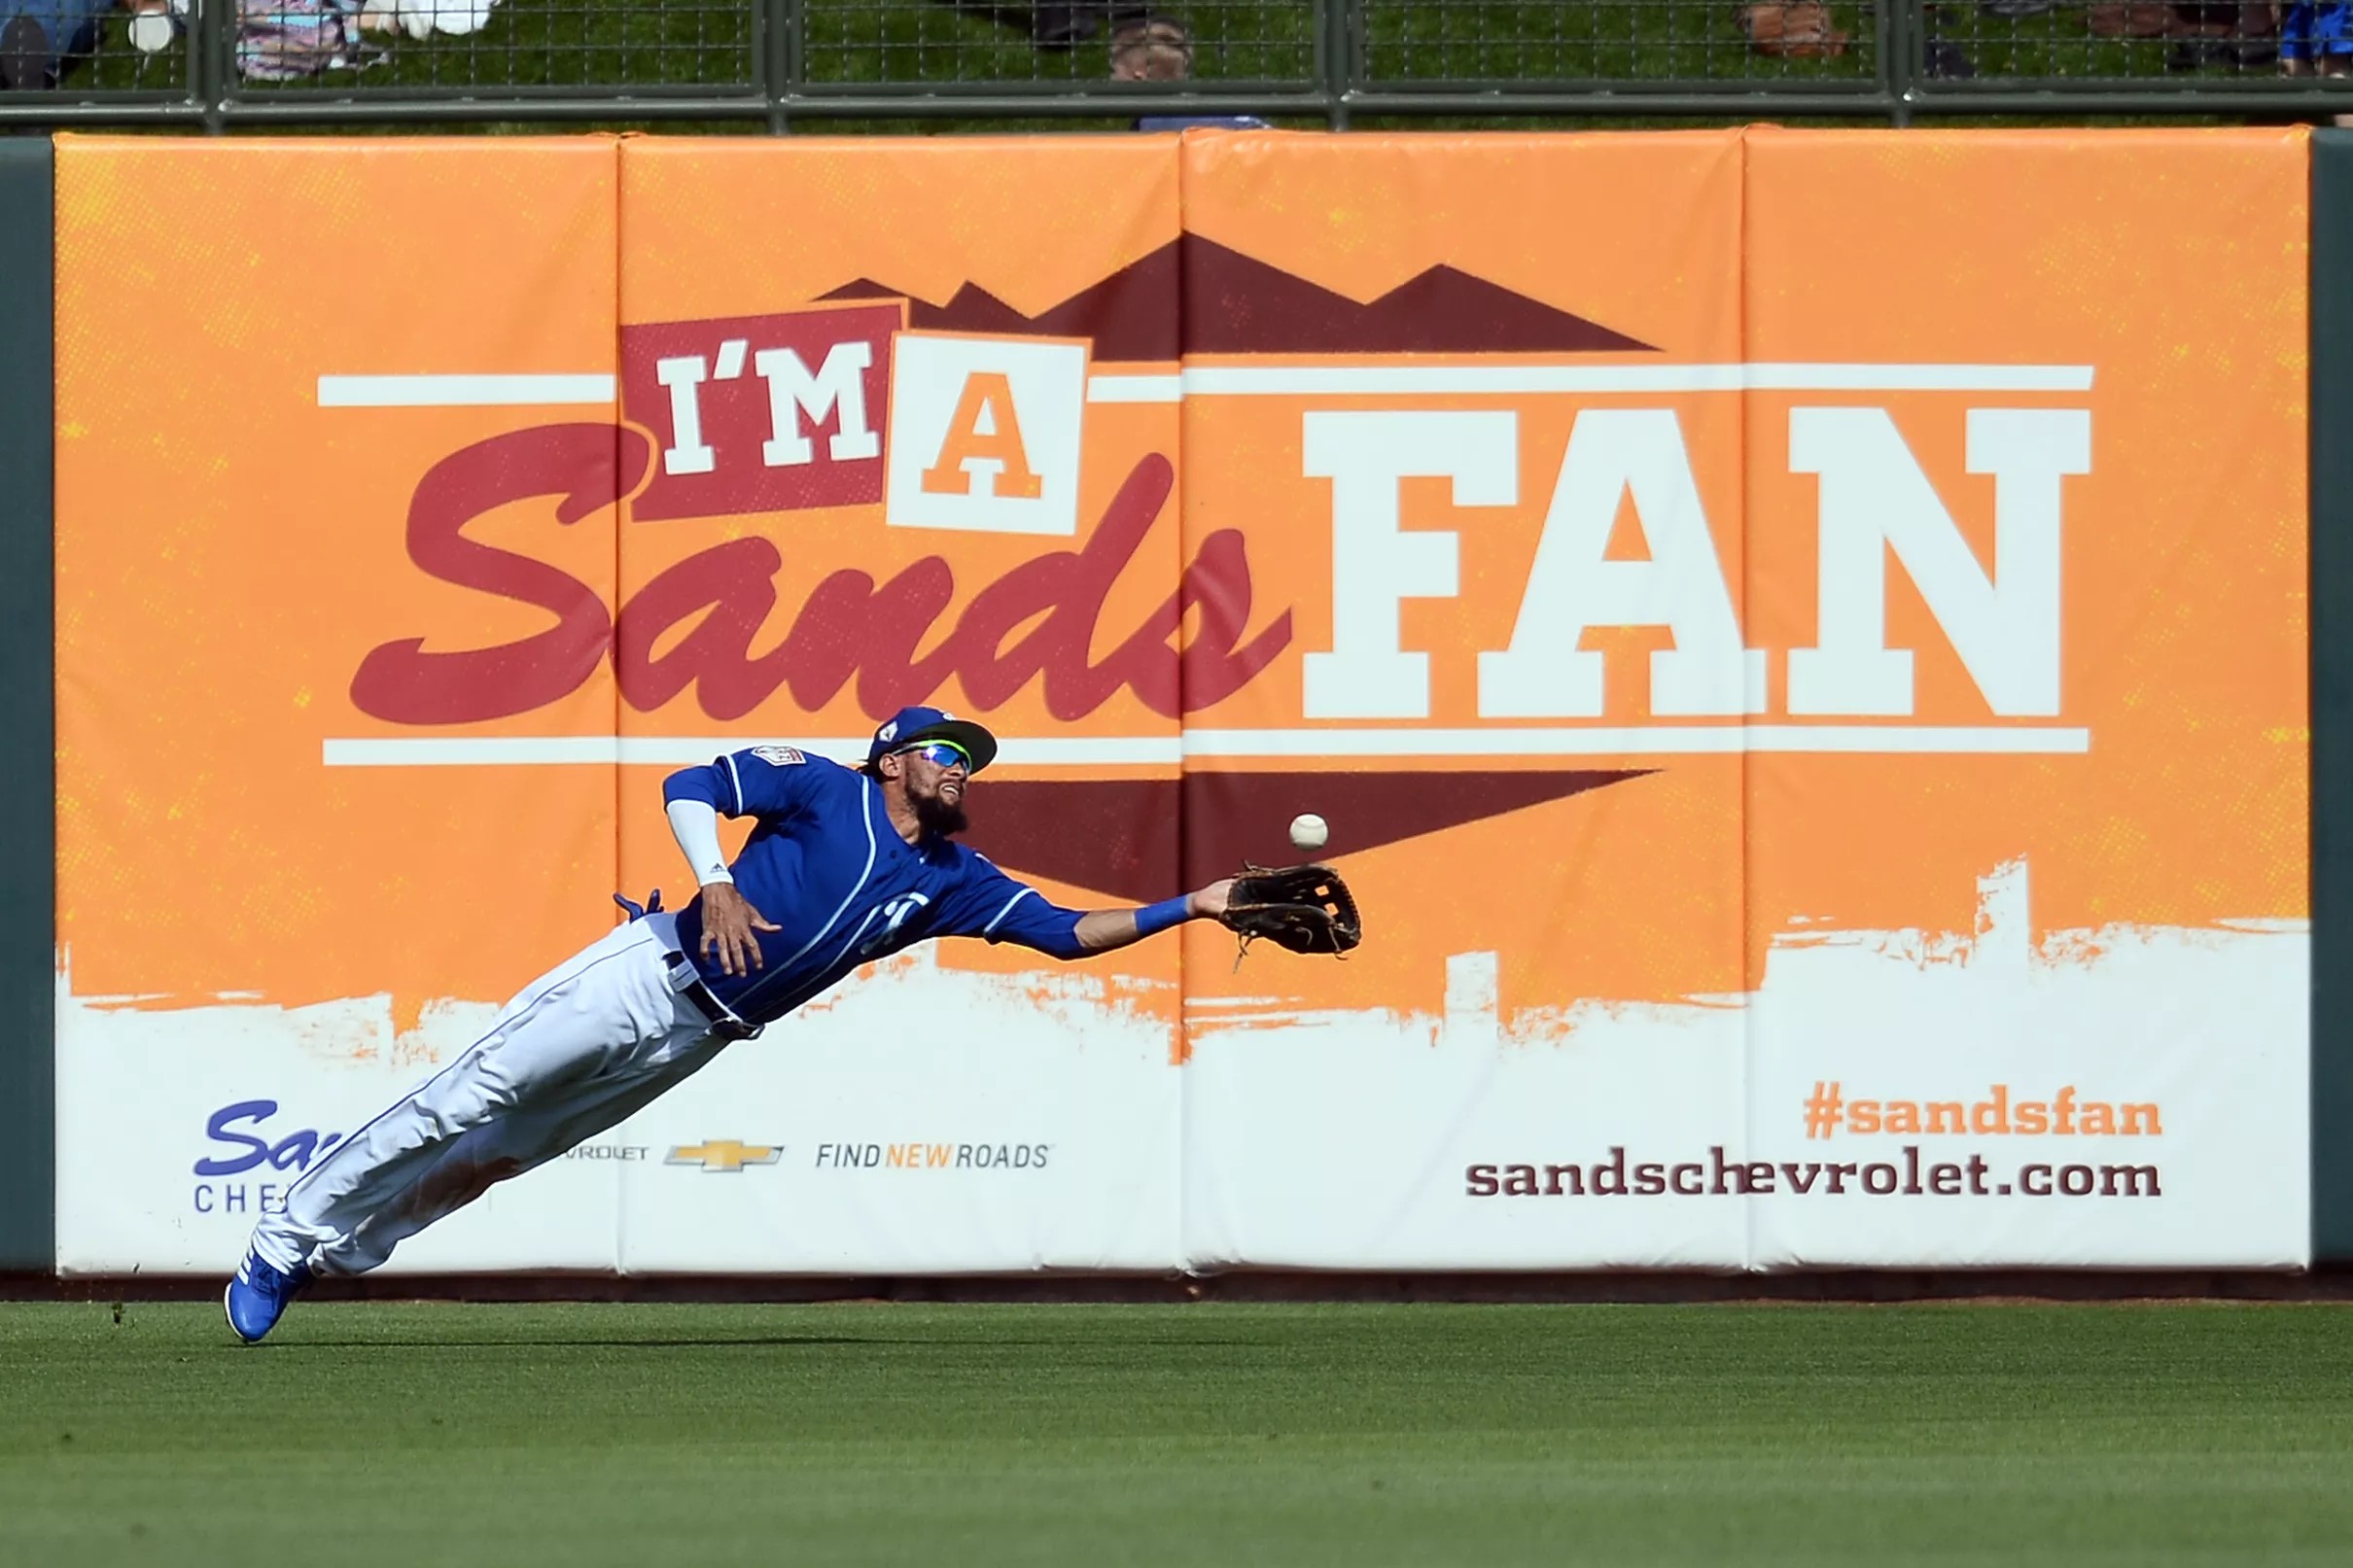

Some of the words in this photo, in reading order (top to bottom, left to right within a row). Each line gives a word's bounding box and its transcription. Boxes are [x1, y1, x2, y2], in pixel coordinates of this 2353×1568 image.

[656, 338, 880, 475] I'M
[921, 370, 1042, 499] A
[349, 421, 1292, 725] Sands
[1302, 406, 2091, 719] FAN
[1803, 1081, 2162, 1138] #sandsfan
[565, 1146, 650, 1160] VROLET
[816, 1144, 881, 1167] FIND
[886, 1144, 953, 1167] NEW
[956, 1144, 1049, 1167] ROADS
[1465, 1145, 2162, 1197] sandschevrolet.com
